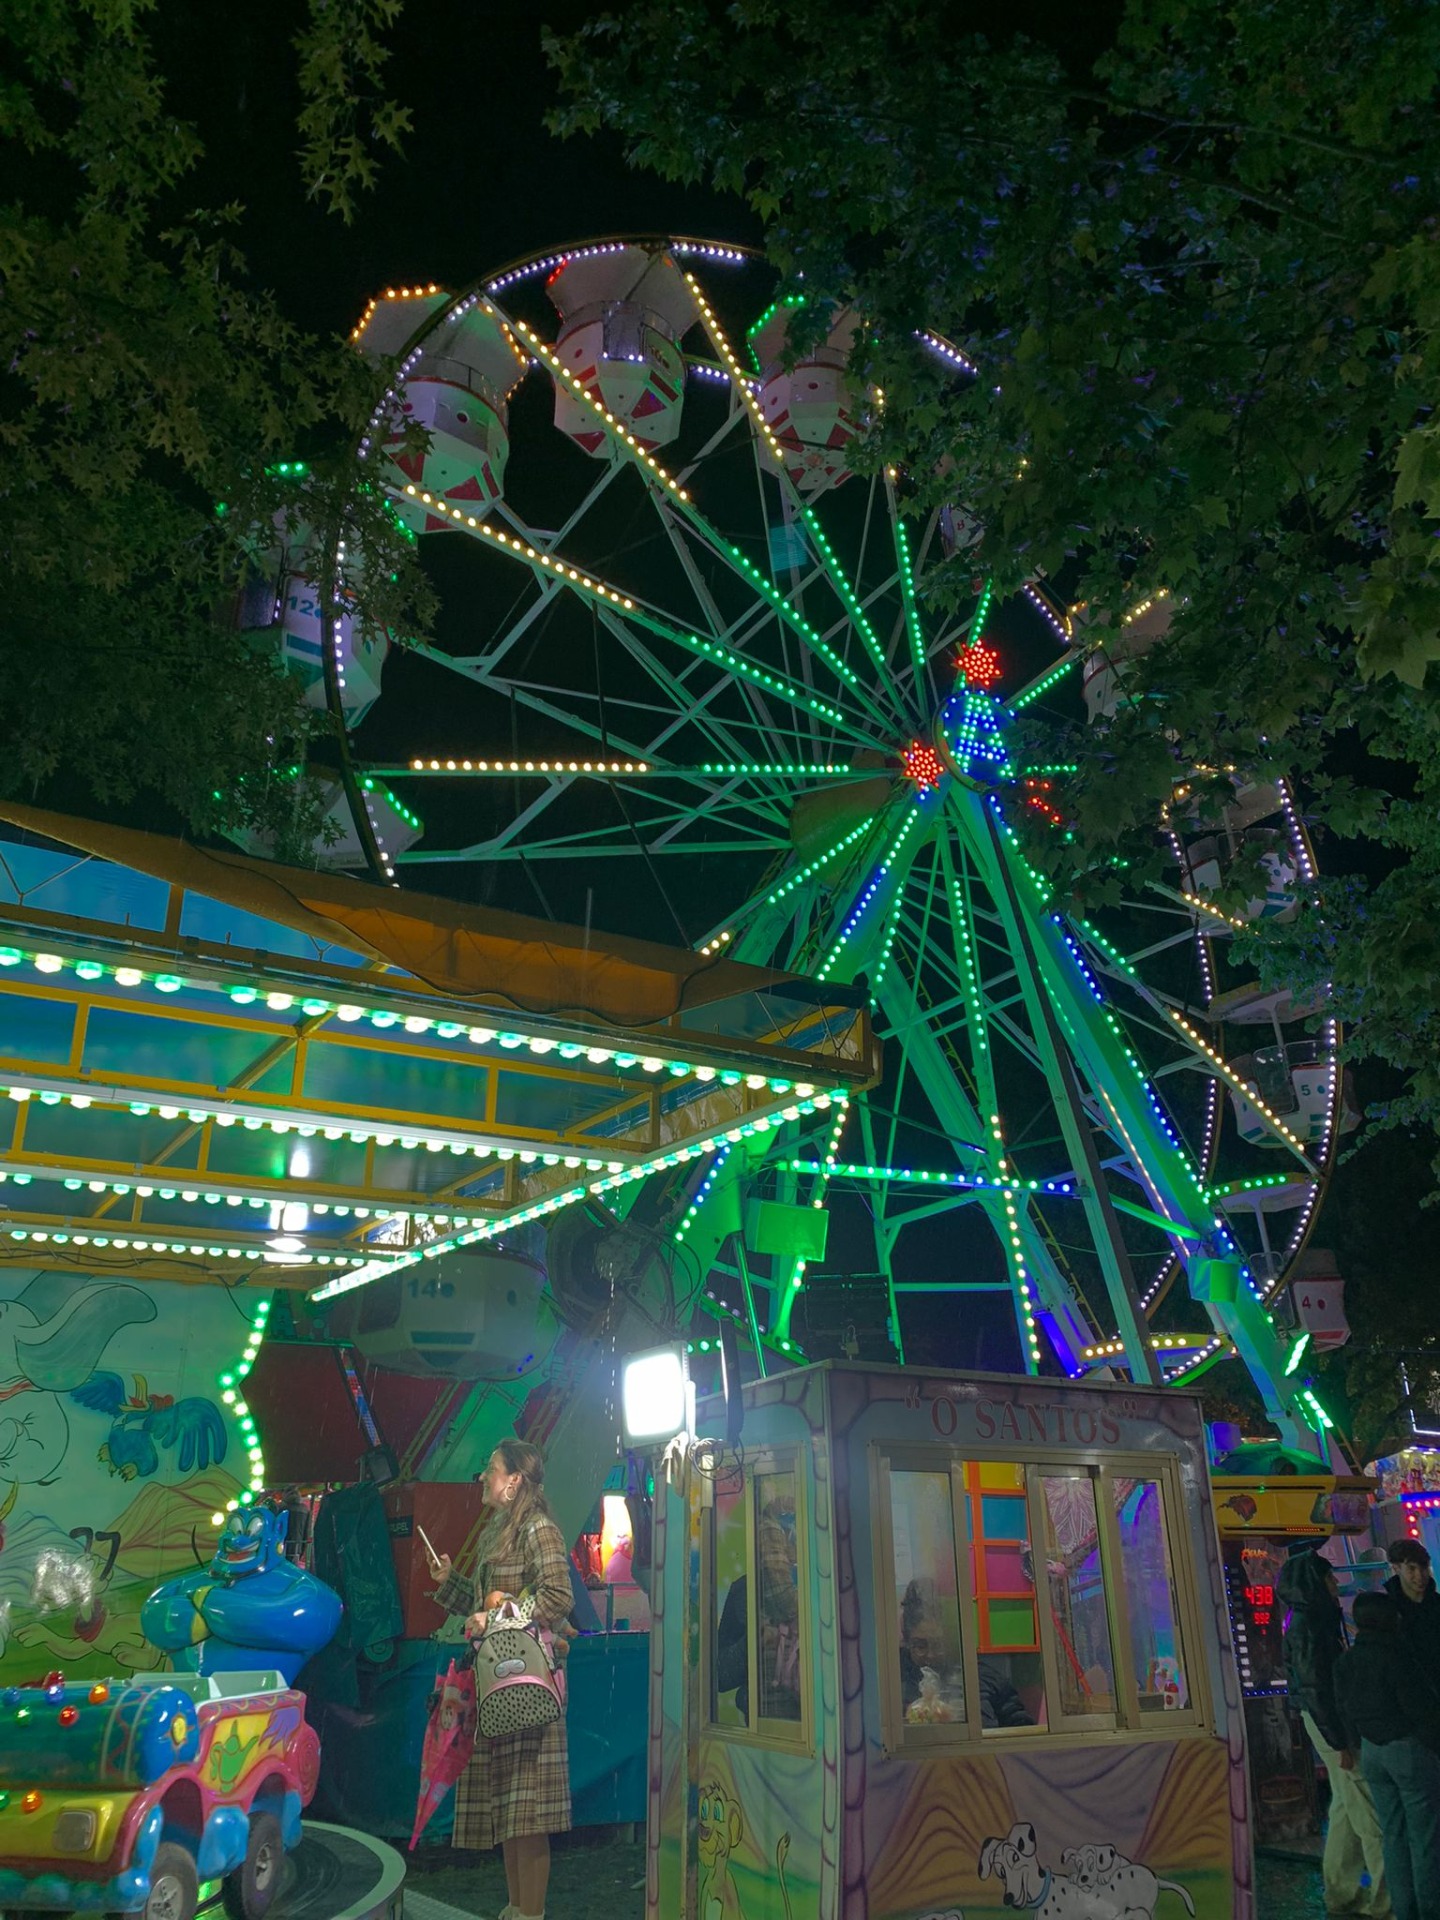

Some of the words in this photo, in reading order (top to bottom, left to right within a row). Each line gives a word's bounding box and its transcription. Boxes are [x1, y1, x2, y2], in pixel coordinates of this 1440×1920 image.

[287, 596, 314, 617] 12
[1300, 1084, 1311, 1097] 5
[408, 1278, 437, 1299] 14
[1301, 1295, 1312, 1310] 4
[1244, 1585, 1273, 1606] 438
